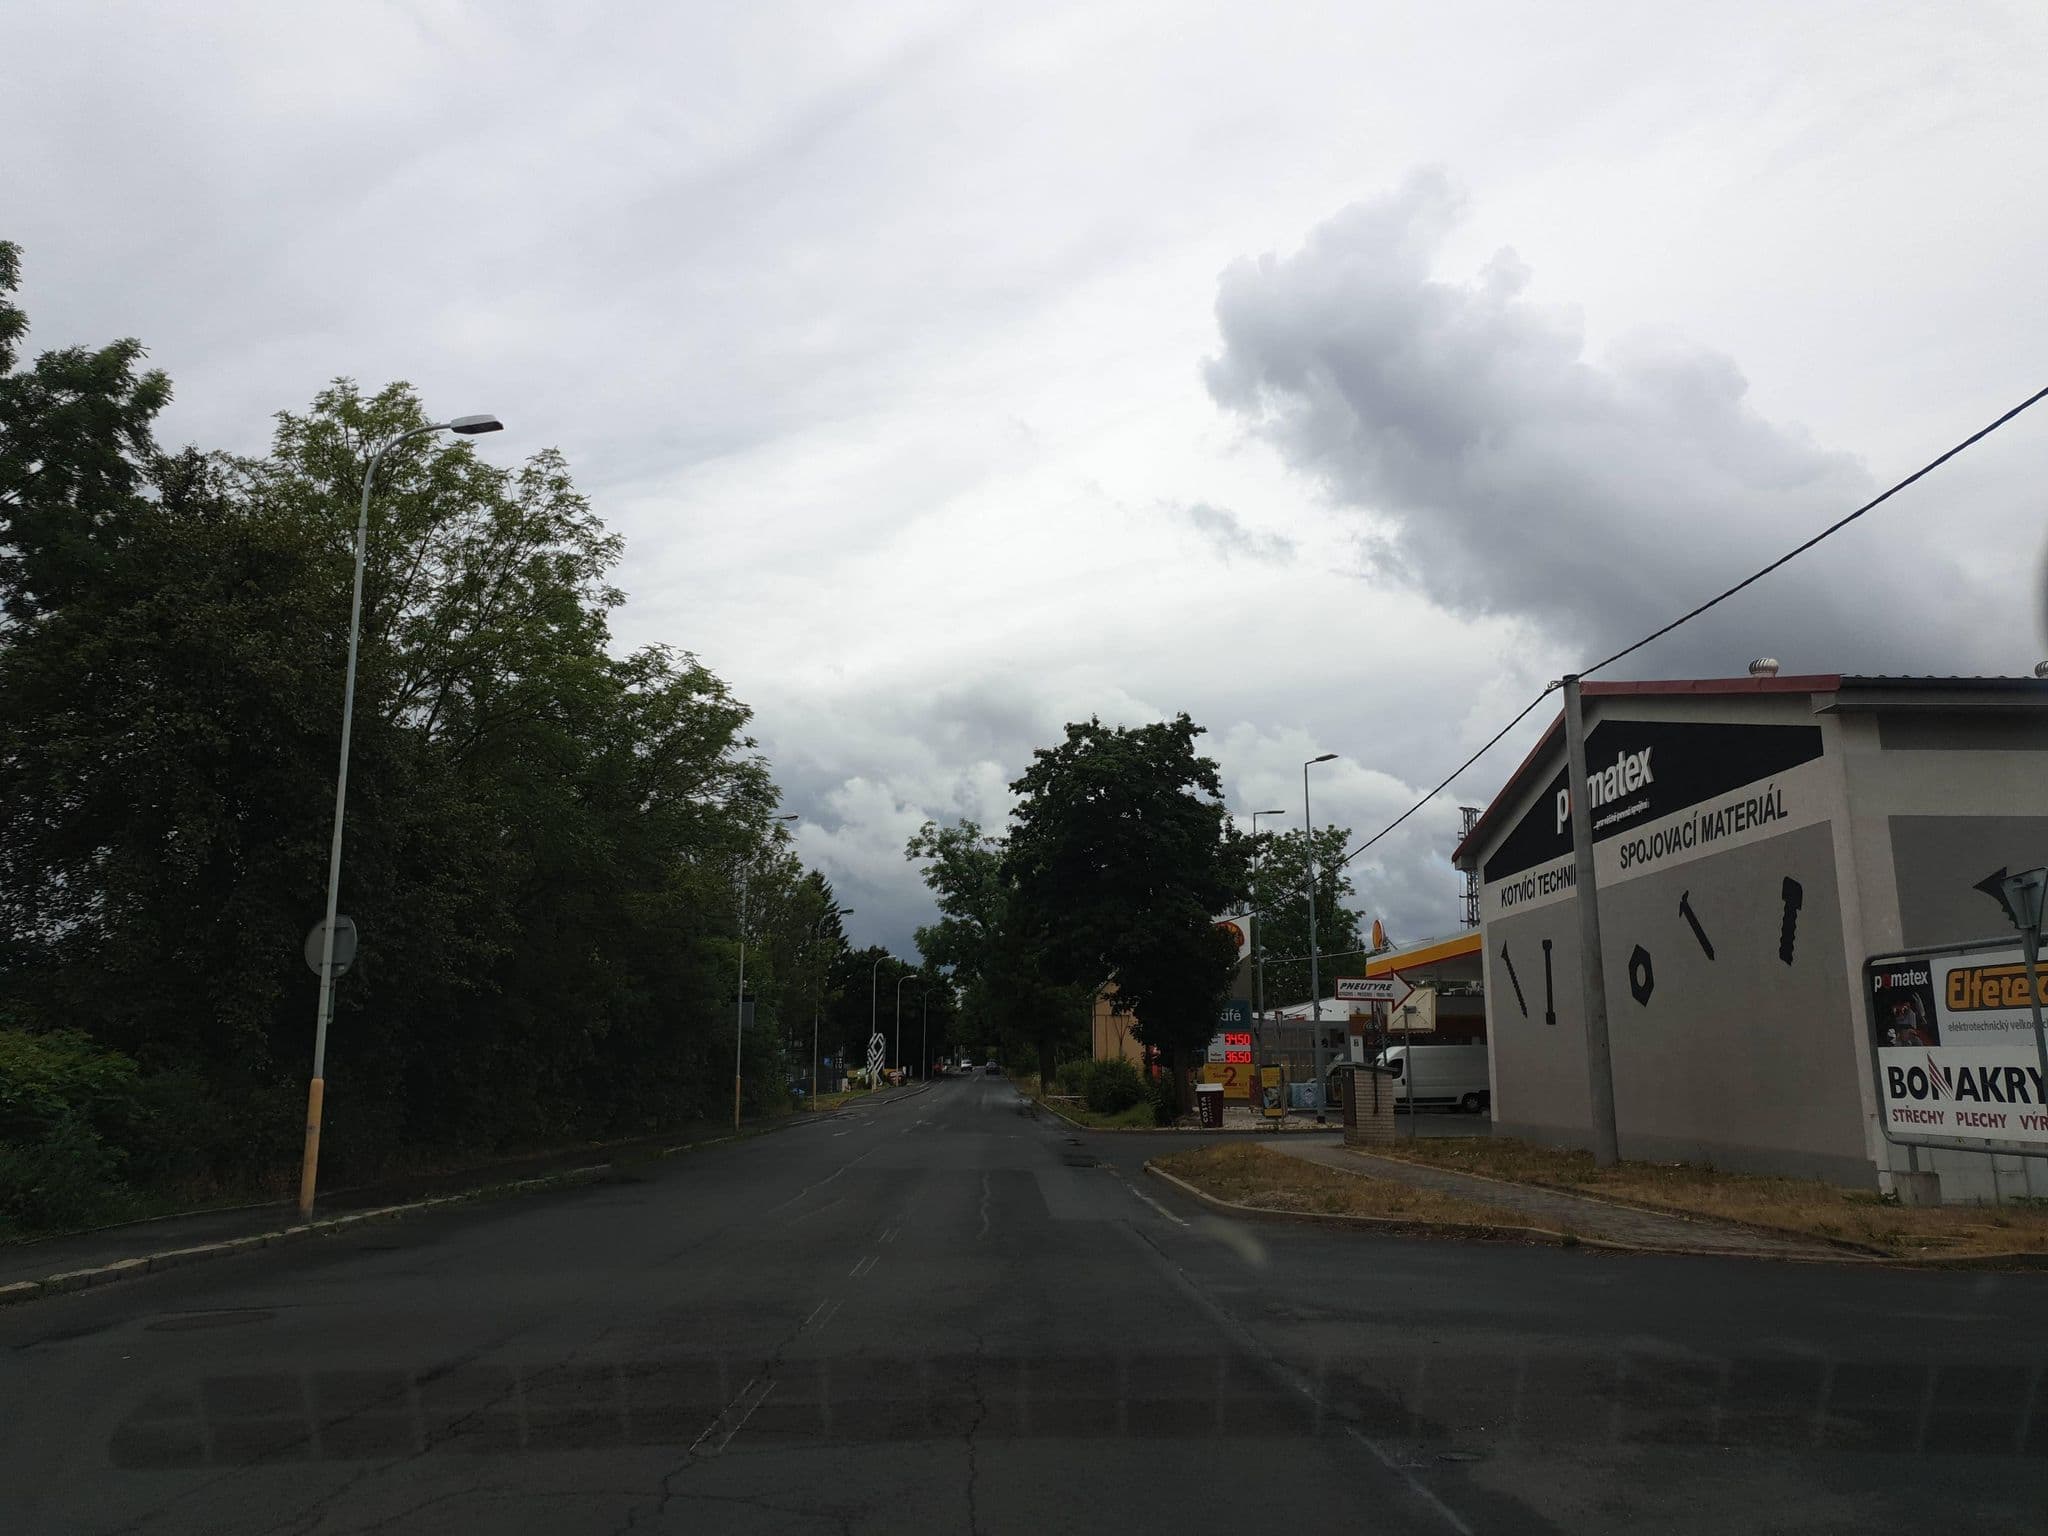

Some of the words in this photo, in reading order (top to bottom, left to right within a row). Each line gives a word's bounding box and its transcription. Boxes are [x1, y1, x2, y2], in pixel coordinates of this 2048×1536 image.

[1620, 812, 1697, 869] SPOJOVACÍ
[1701, 784, 1788, 844] MATERIÁL
[1501, 872, 1536, 908] KOTVÍCÍ
[1340, 982, 1393, 991] PNEUTYRE
[1893, 1105, 1945, 1125] STŘECHY
[1956, 1111, 2007, 1130] PLECHY
